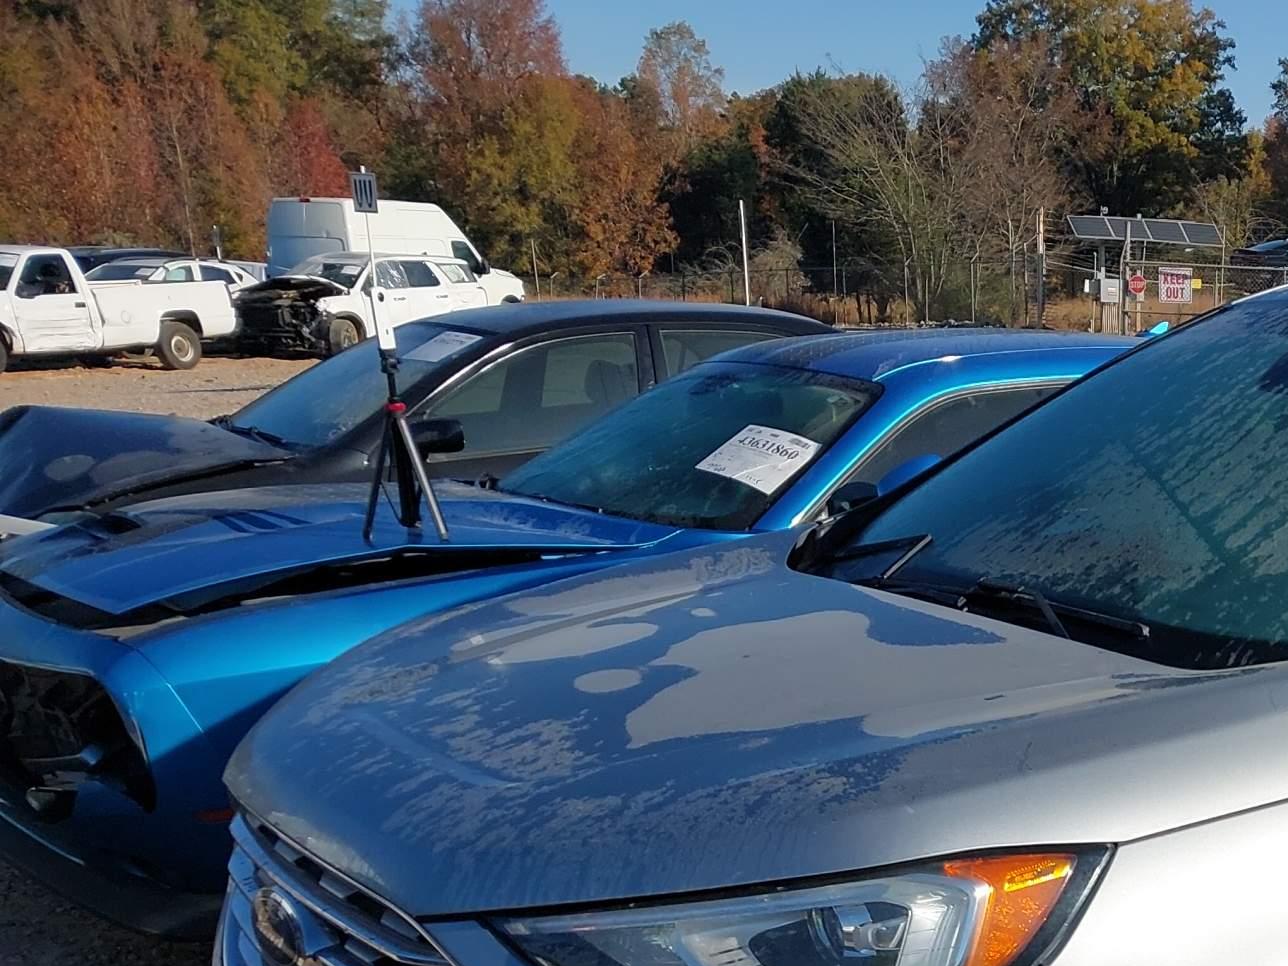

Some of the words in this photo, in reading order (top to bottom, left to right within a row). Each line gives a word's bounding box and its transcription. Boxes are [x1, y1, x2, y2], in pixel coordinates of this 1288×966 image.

[1130, 281, 1145, 289] STOP
[1166, 286, 1186, 299] OUT
[738, 436, 800, 460] 43631860
